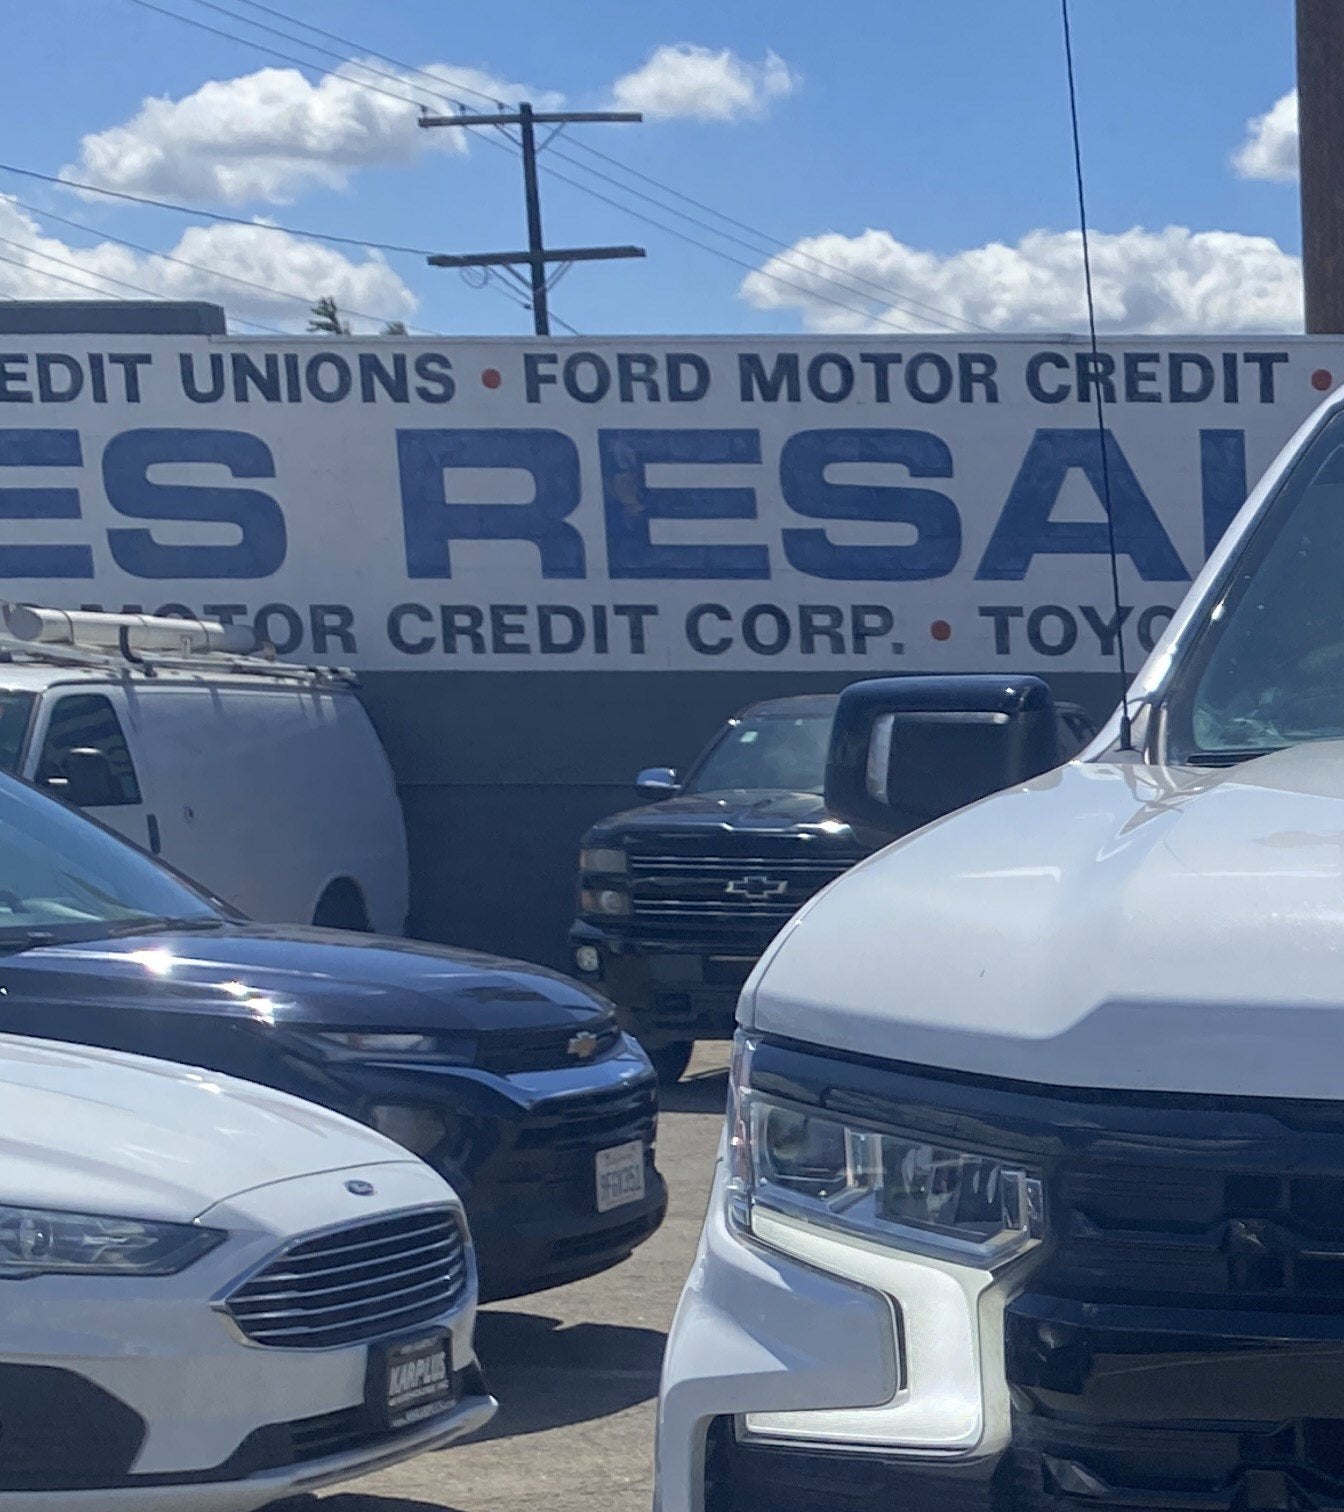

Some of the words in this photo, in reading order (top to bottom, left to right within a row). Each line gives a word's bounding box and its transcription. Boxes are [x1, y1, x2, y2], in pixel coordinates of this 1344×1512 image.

[180, 352, 456, 403] UNIONS
[523, 352, 711, 403] FORD
[737, 352, 1000, 404] MOTOR
[1024, 351, 1288, 404] CREDIT
[387, 602, 658, 656] CREDIT
[684, 603, 904, 656] CORP.
